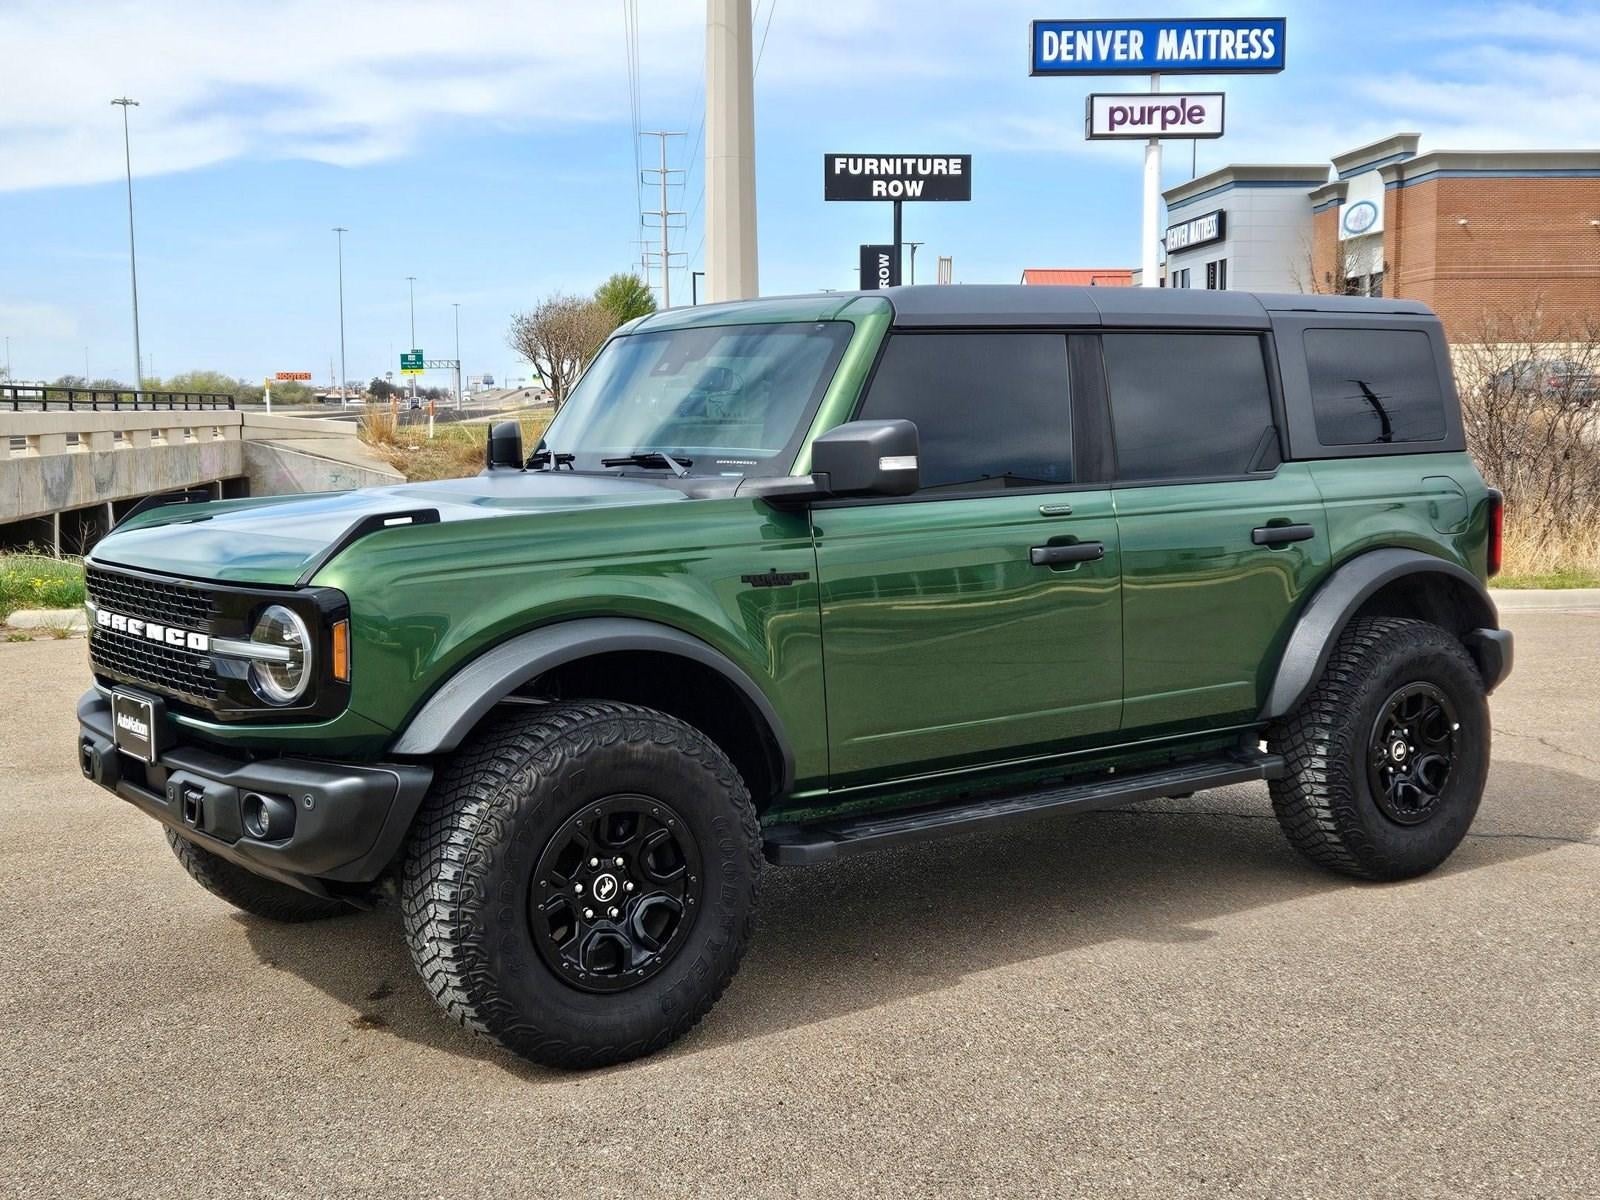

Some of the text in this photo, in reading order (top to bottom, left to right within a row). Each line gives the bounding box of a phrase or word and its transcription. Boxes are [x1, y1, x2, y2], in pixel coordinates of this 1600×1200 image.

[1043, 28, 1275, 61] DENVER MATTRESS
[1109, 98, 1206, 131] purple
[834, 157, 962, 175] FURNITURE
[872, 180, 925, 197] ROW
[1190, 214, 1217, 244] MATTRESS
[879, 253, 890, 289] ROW
[276, 371, 312, 380] HOOTERS
[97, 609, 209, 650] BRONCO
